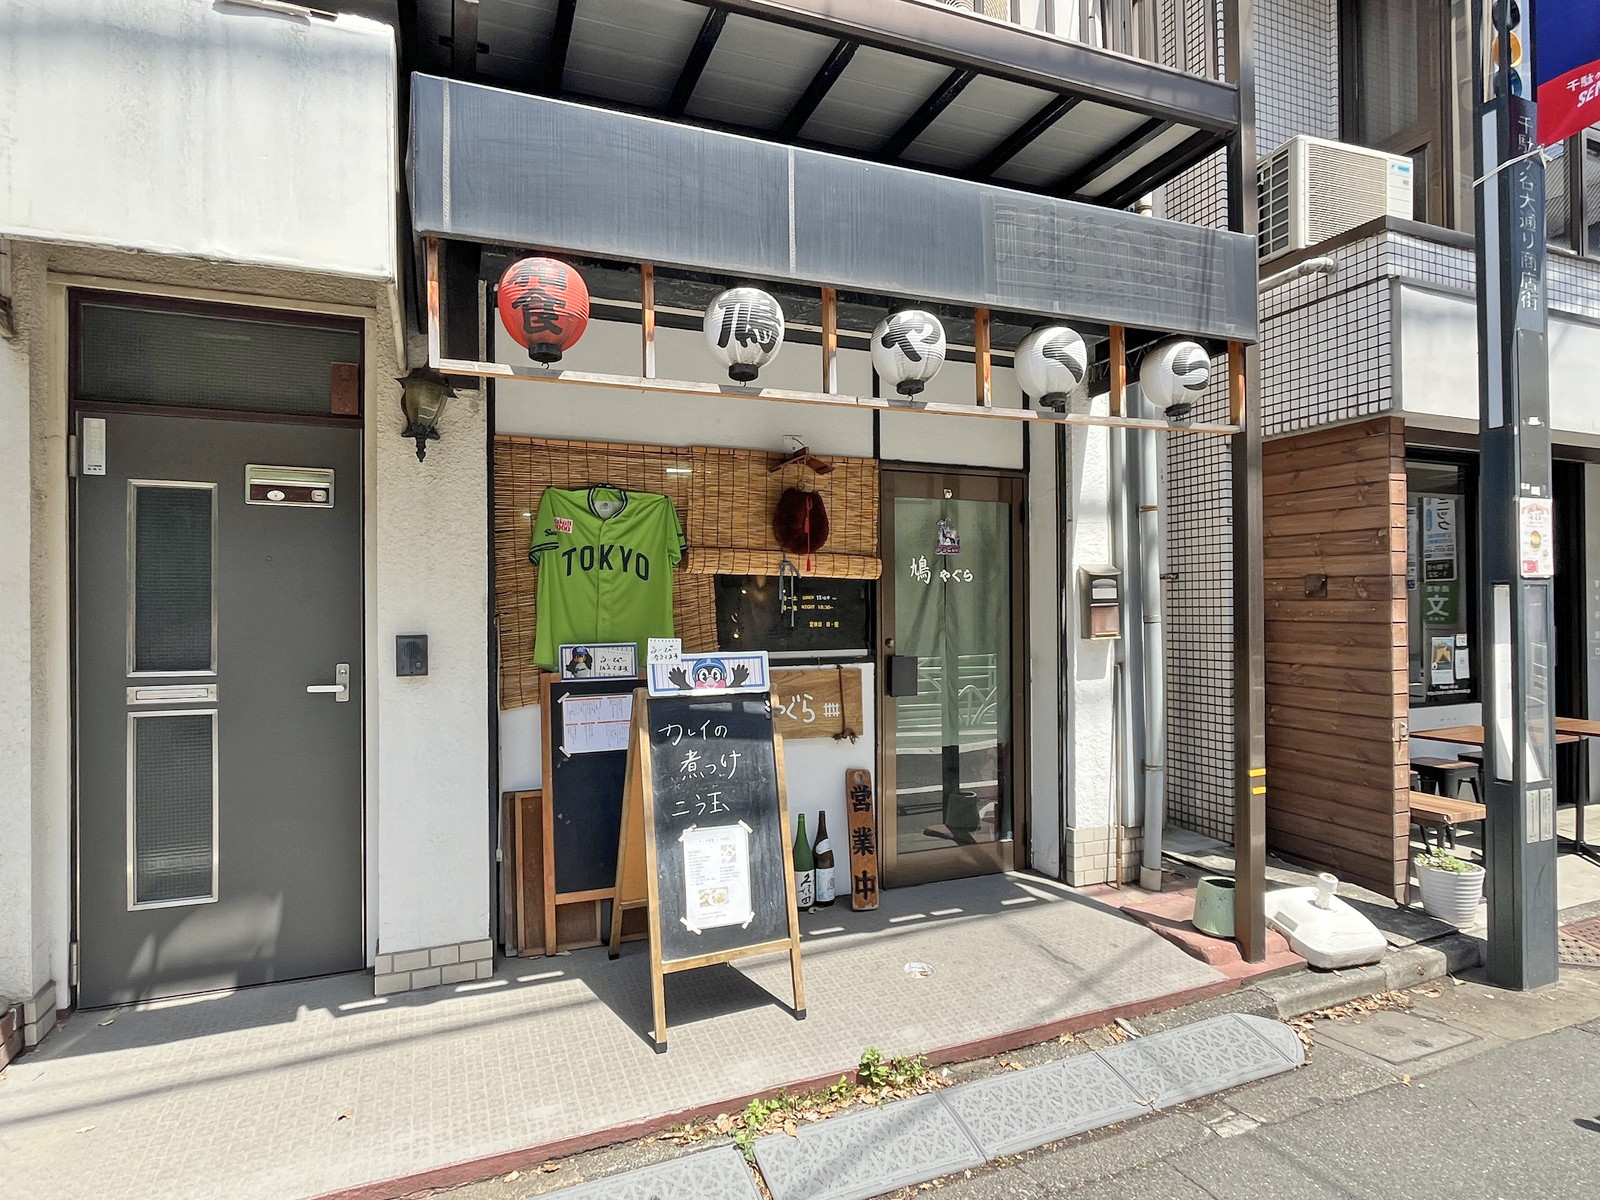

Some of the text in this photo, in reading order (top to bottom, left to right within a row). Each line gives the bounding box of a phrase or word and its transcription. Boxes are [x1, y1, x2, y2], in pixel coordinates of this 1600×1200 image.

[507, 259, 568, 335] 和食
[881, 312, 941, 362] や
[561, 544, 650, 582] TOKYO
[910, 555, 974, 585] 鳩 やぐら
[657, 719, 728, 746] カレイの
[679, 749, 742, 781] 煮つけ
[850, 785, 877, 900] 営業中
